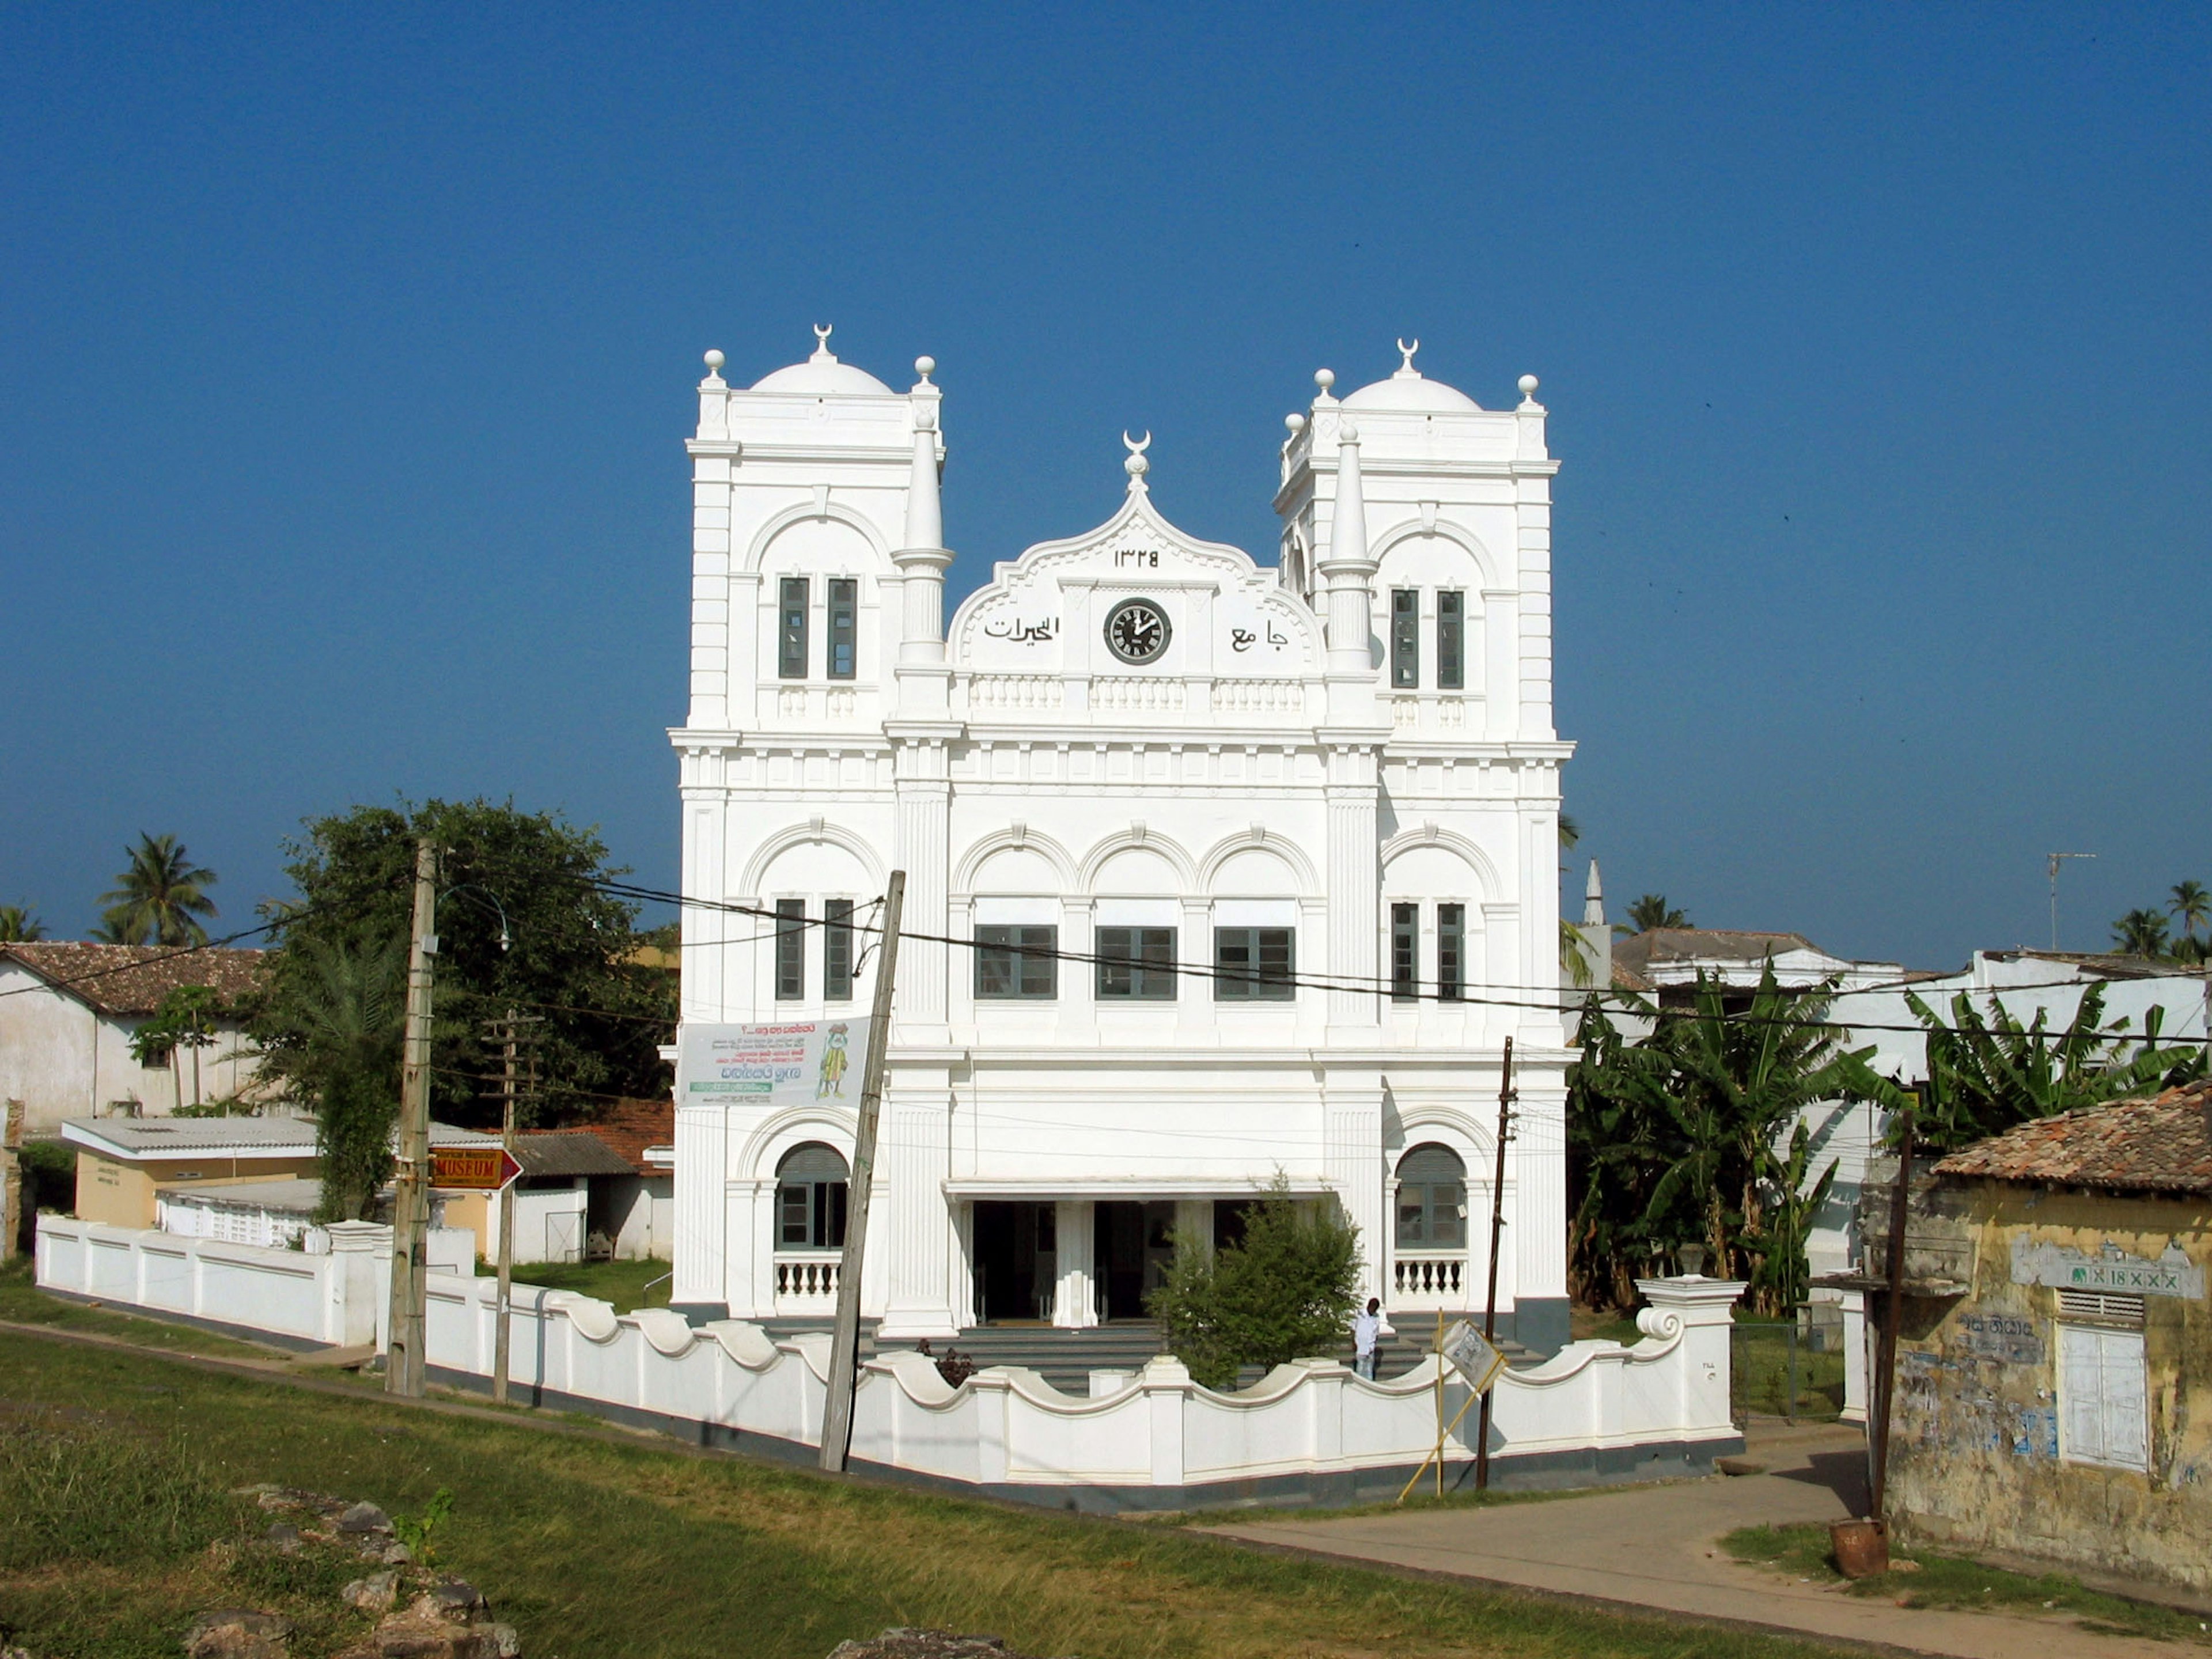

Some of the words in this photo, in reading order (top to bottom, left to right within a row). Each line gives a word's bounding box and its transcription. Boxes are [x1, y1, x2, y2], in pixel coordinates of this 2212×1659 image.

[984, 616, 1060, 646] الخيرات
[435, 1160, 494, 1176] MUSEUM
[2111, 1270, 2126, 1286] 18
